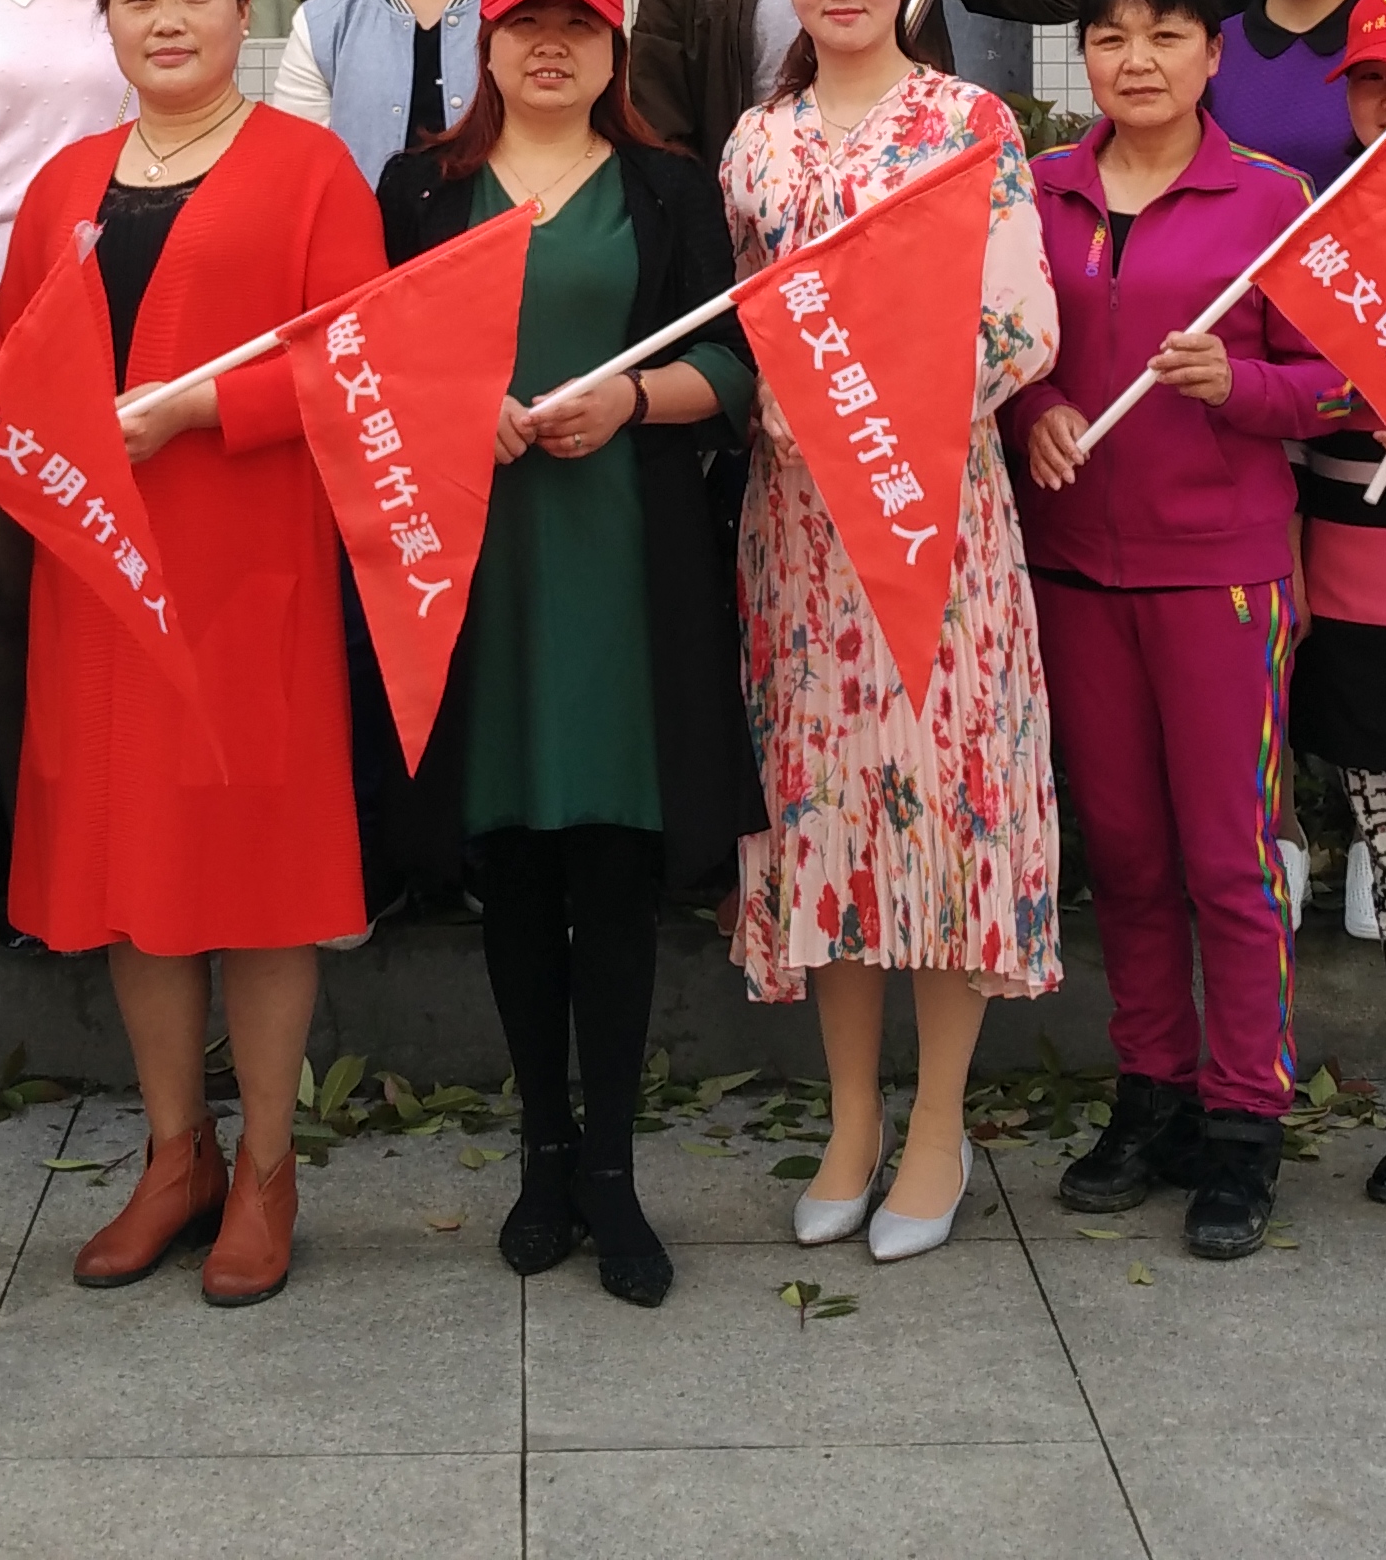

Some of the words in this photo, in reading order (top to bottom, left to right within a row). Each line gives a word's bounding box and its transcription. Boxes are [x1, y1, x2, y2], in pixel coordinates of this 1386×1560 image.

[326, 312, 452, 617] 做文明竹溪人
[773, 270, 938, 565] 做文明竹溪人
